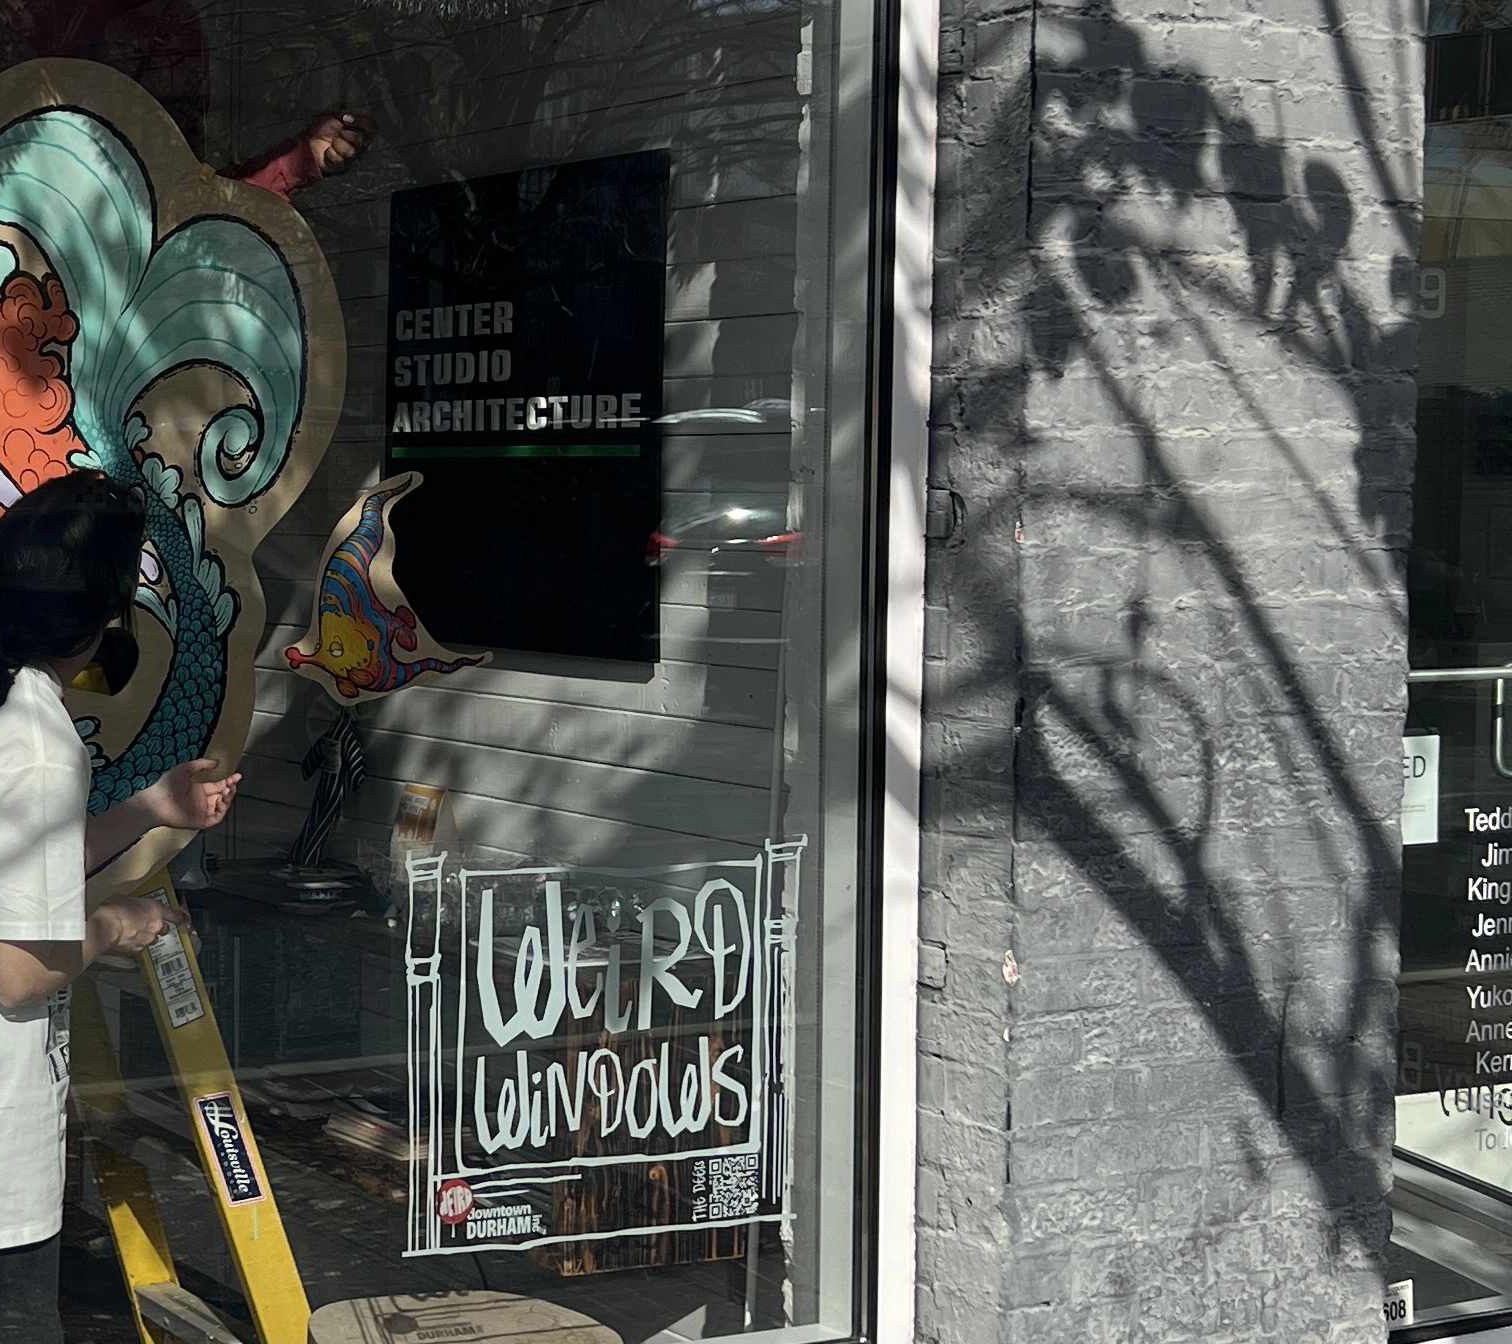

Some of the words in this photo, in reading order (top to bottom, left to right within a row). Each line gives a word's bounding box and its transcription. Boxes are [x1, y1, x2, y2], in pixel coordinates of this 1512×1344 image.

[395, 301, 513, 341] CENTER
[394, 349, 512, 387] STUDIO
[392, 393, 641, 433] ARCHITECTURE
[466, 1215, 531, 1239] DURHAM
[467, 1204, 532, 1220] downtown
